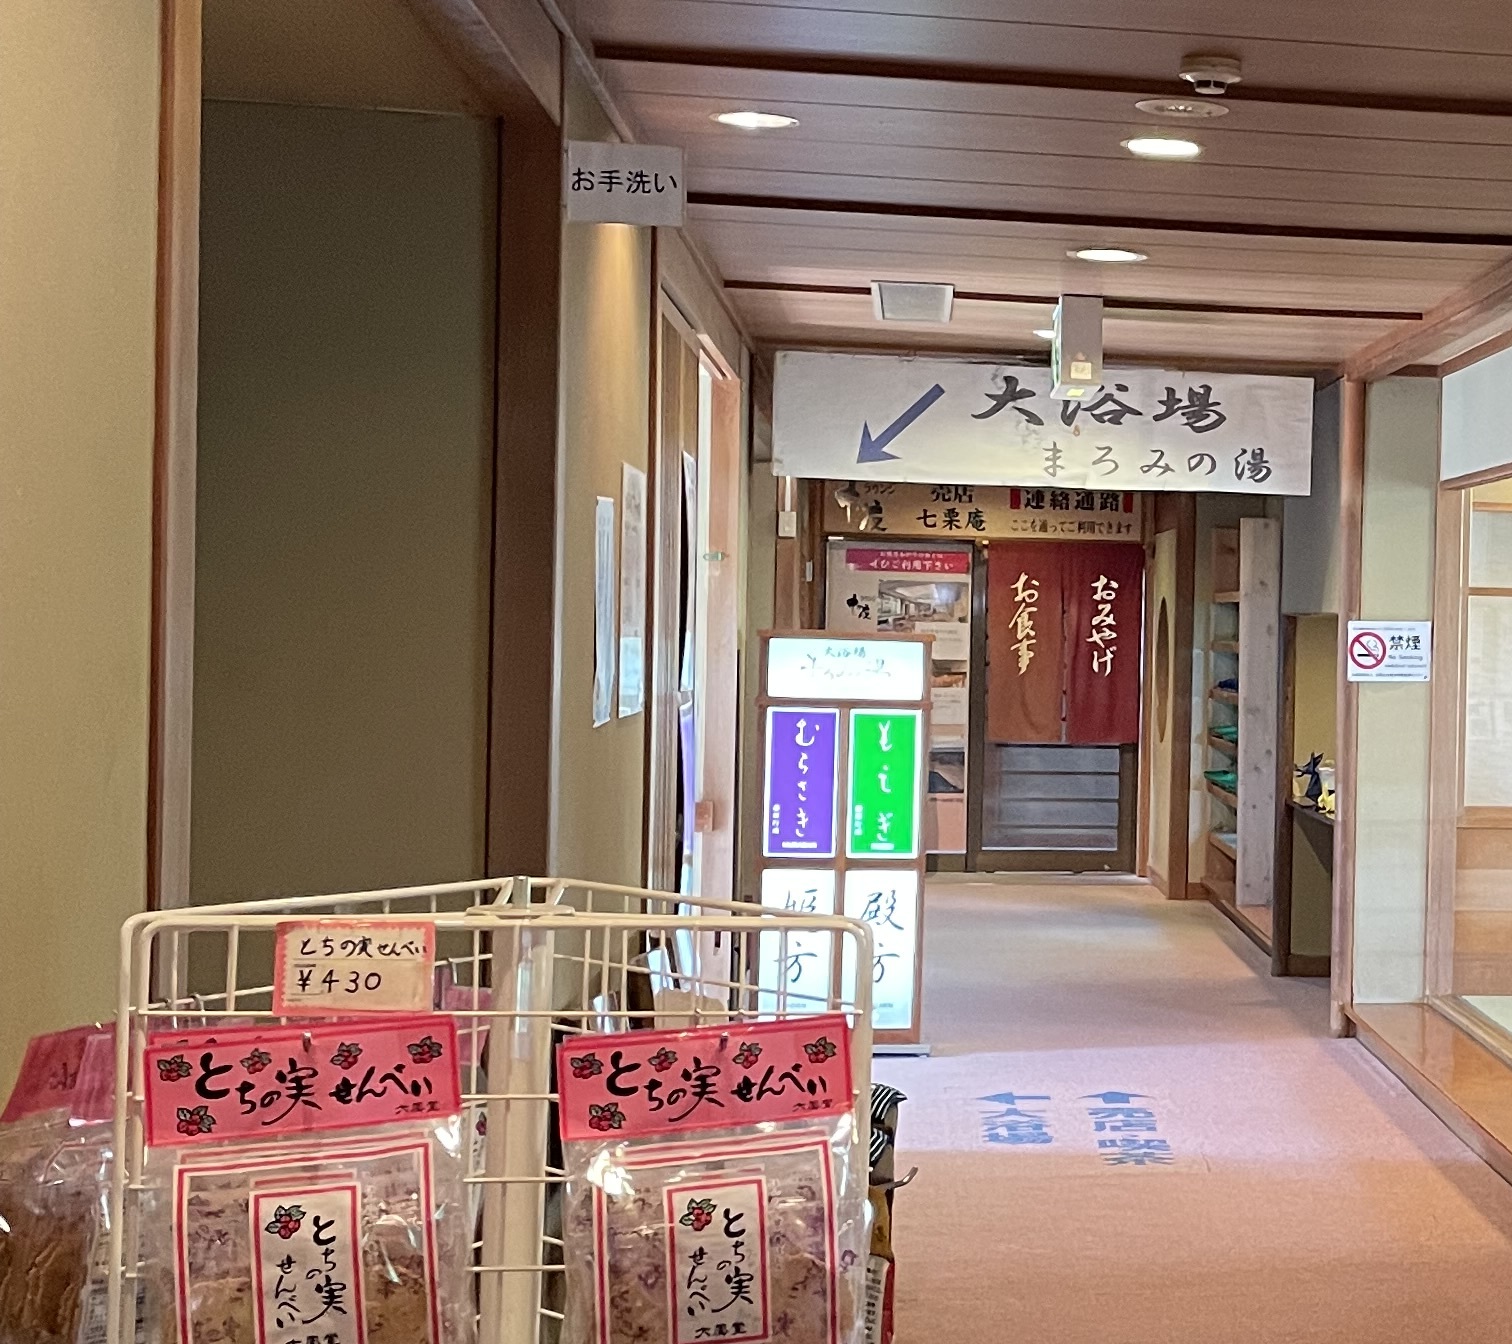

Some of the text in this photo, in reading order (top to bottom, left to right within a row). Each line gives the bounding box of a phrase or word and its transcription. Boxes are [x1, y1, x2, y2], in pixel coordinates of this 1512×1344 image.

[571, 167, 678, 194] お手洗い
[971, 375, 1228, 434] 大浴場
[1042, 441, 1273, 484] まろみの湯
[916, 507, 986, 532] 七栗庵
[931, 485, 974, 504] 売店
[1024, 488, 1120, 512] 連絡通路
[1009, 572, 1040, 676] お食事
[1086, 574, 1119, 677] おみやげ
[1389, 635, 1421, 650] 禁煙
[795, 718, 820, 838] むらさき
[297, 968, 382, 994] ¥430
[302, 1215, 347, 1324] とちの実
[686, 1246, 711, 1318] せんべい
[711, 1207, 755, 1314] とちの実
[274, 1256, 297, 1329] せんべい
